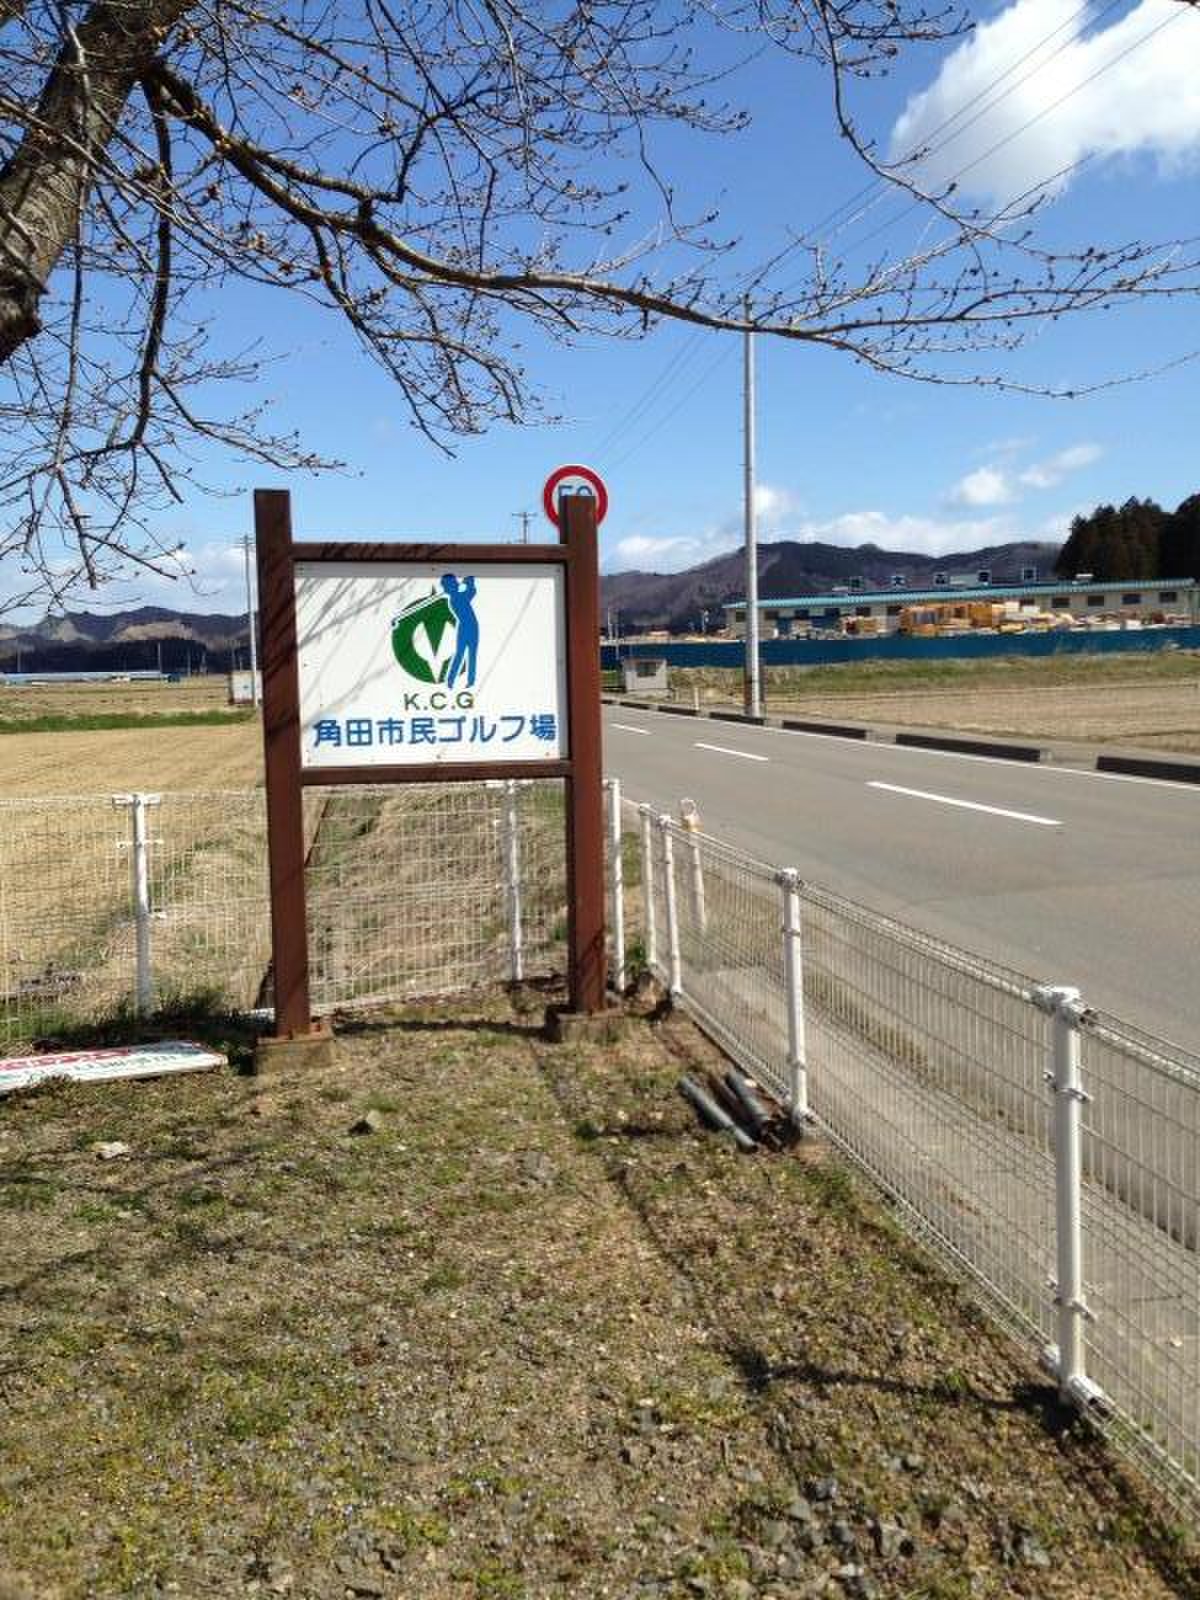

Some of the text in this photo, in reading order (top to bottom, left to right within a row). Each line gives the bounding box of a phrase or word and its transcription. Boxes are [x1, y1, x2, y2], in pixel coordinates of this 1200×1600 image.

[403, 691, 474, 711] K.C.G
[312, 713, 557, 748] 角田市民ゴルフ場
